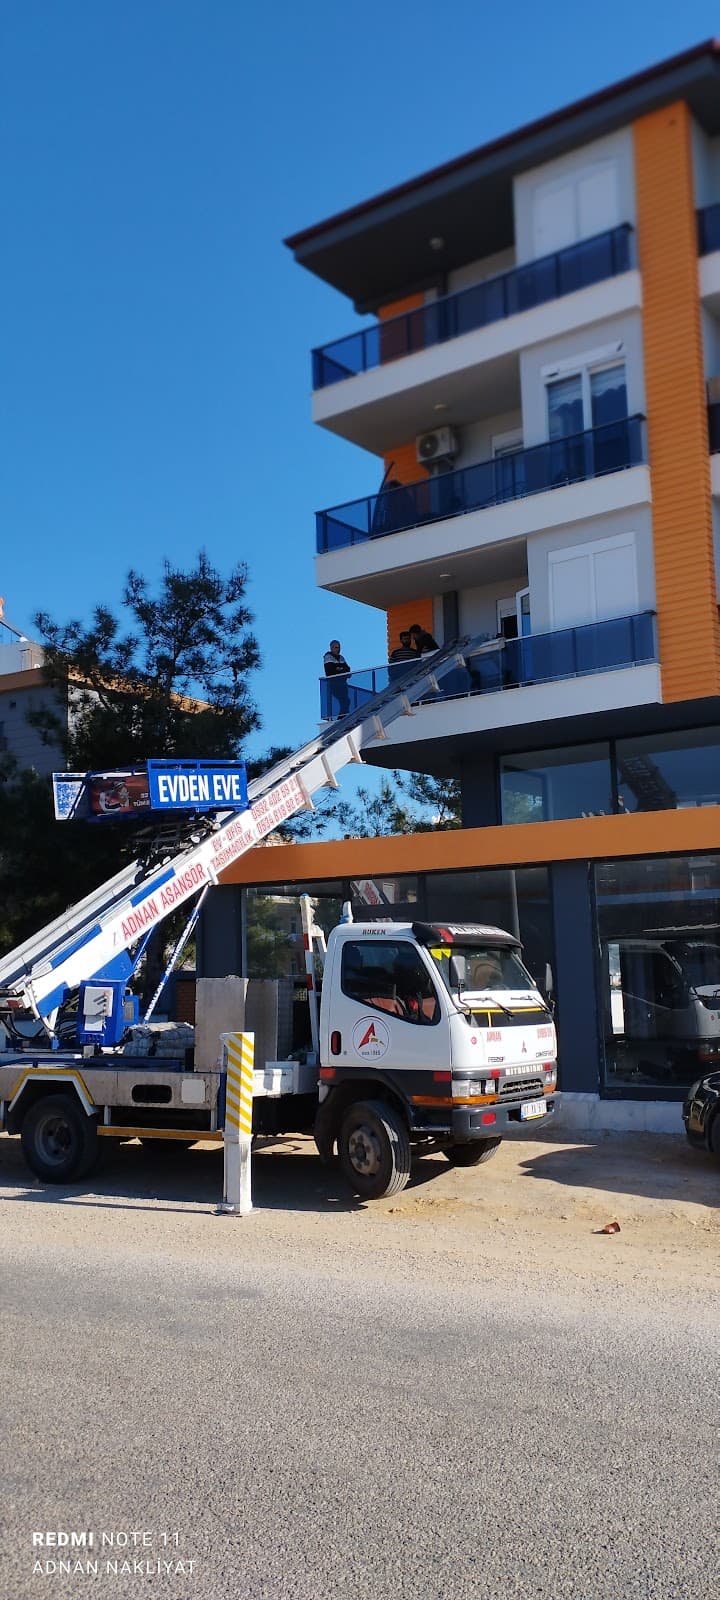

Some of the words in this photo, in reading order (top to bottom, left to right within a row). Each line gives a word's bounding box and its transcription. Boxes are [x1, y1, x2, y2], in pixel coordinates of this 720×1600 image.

[158, 774, 210, 803] EVDEN
[212, 774, 242, 801] EVE
[121, 898, 159, 940] ADNAN
[160, 863, 207, 909] ASANSÖR
[505, 1063, 544, 1076] MITSUBISHI
